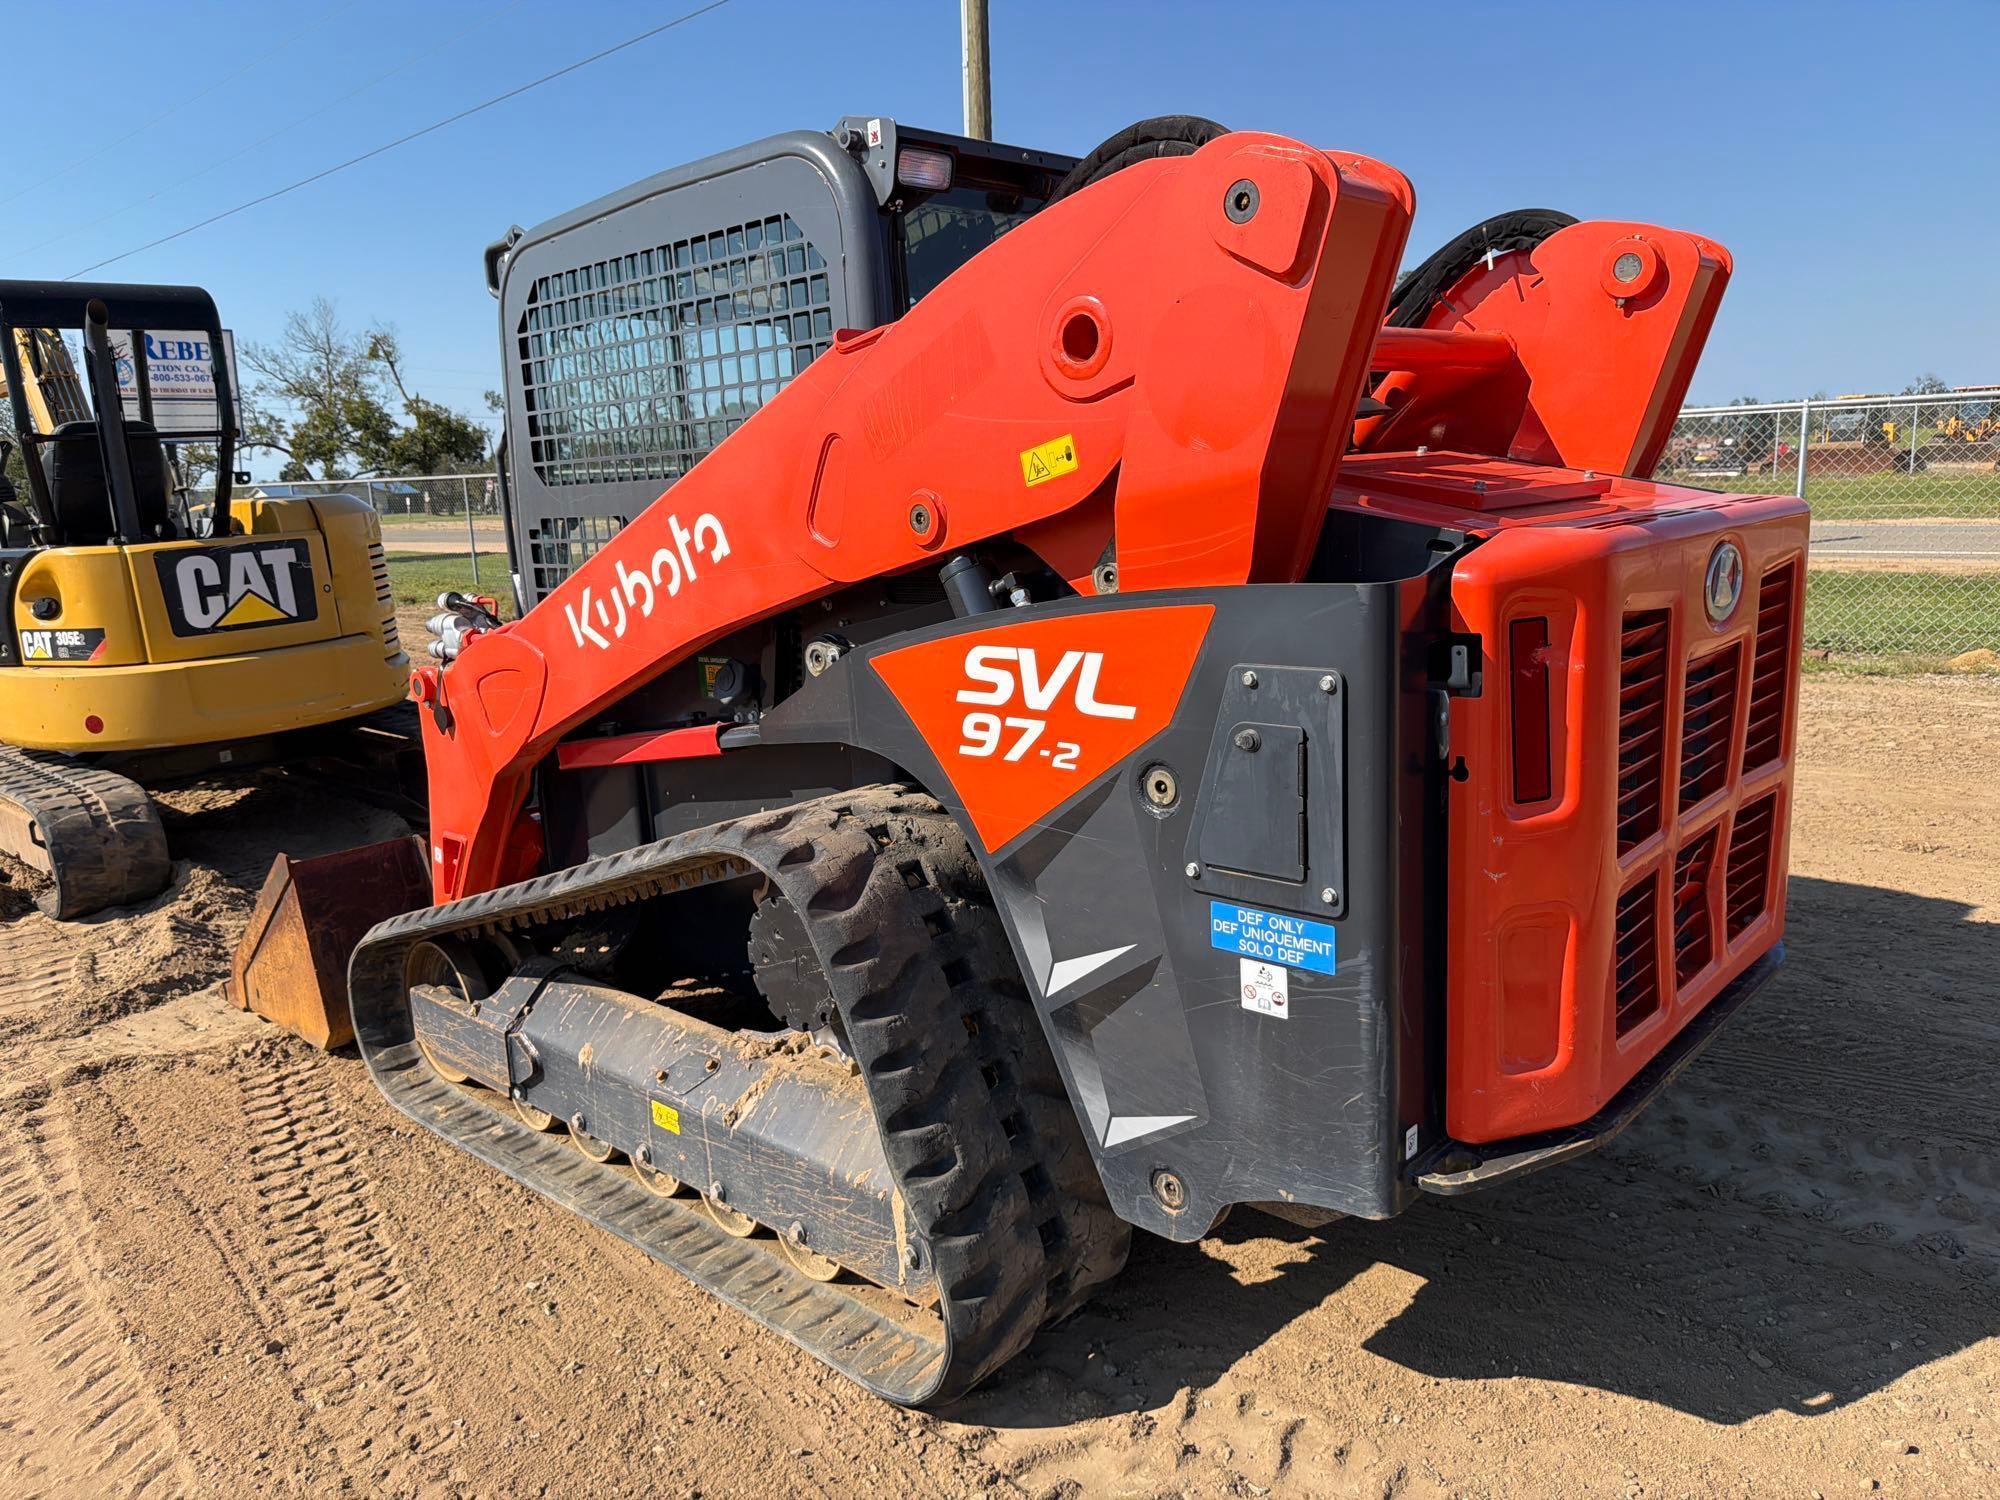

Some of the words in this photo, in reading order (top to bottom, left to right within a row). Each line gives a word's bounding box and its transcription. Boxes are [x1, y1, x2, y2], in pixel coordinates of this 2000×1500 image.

[176, 548, 298, 628] CAT
[564, 513, 731, 650] Kubota
[21, 631, 53, 659] CAT
[956, 645, 1136, 720] SVL
[958, 712, 1081, 770] 97-2
[1213, 919, 1239, 934] DEF
[1242, 926, 1332, 956] UNIQUEMENT
[1238, 910, 1263, 926] DEF
[1268, 917, 1304, 935] ONLY
[1239, 939, 1274, 957] SOLO
[1278, 947, 1304, 963] DEF
